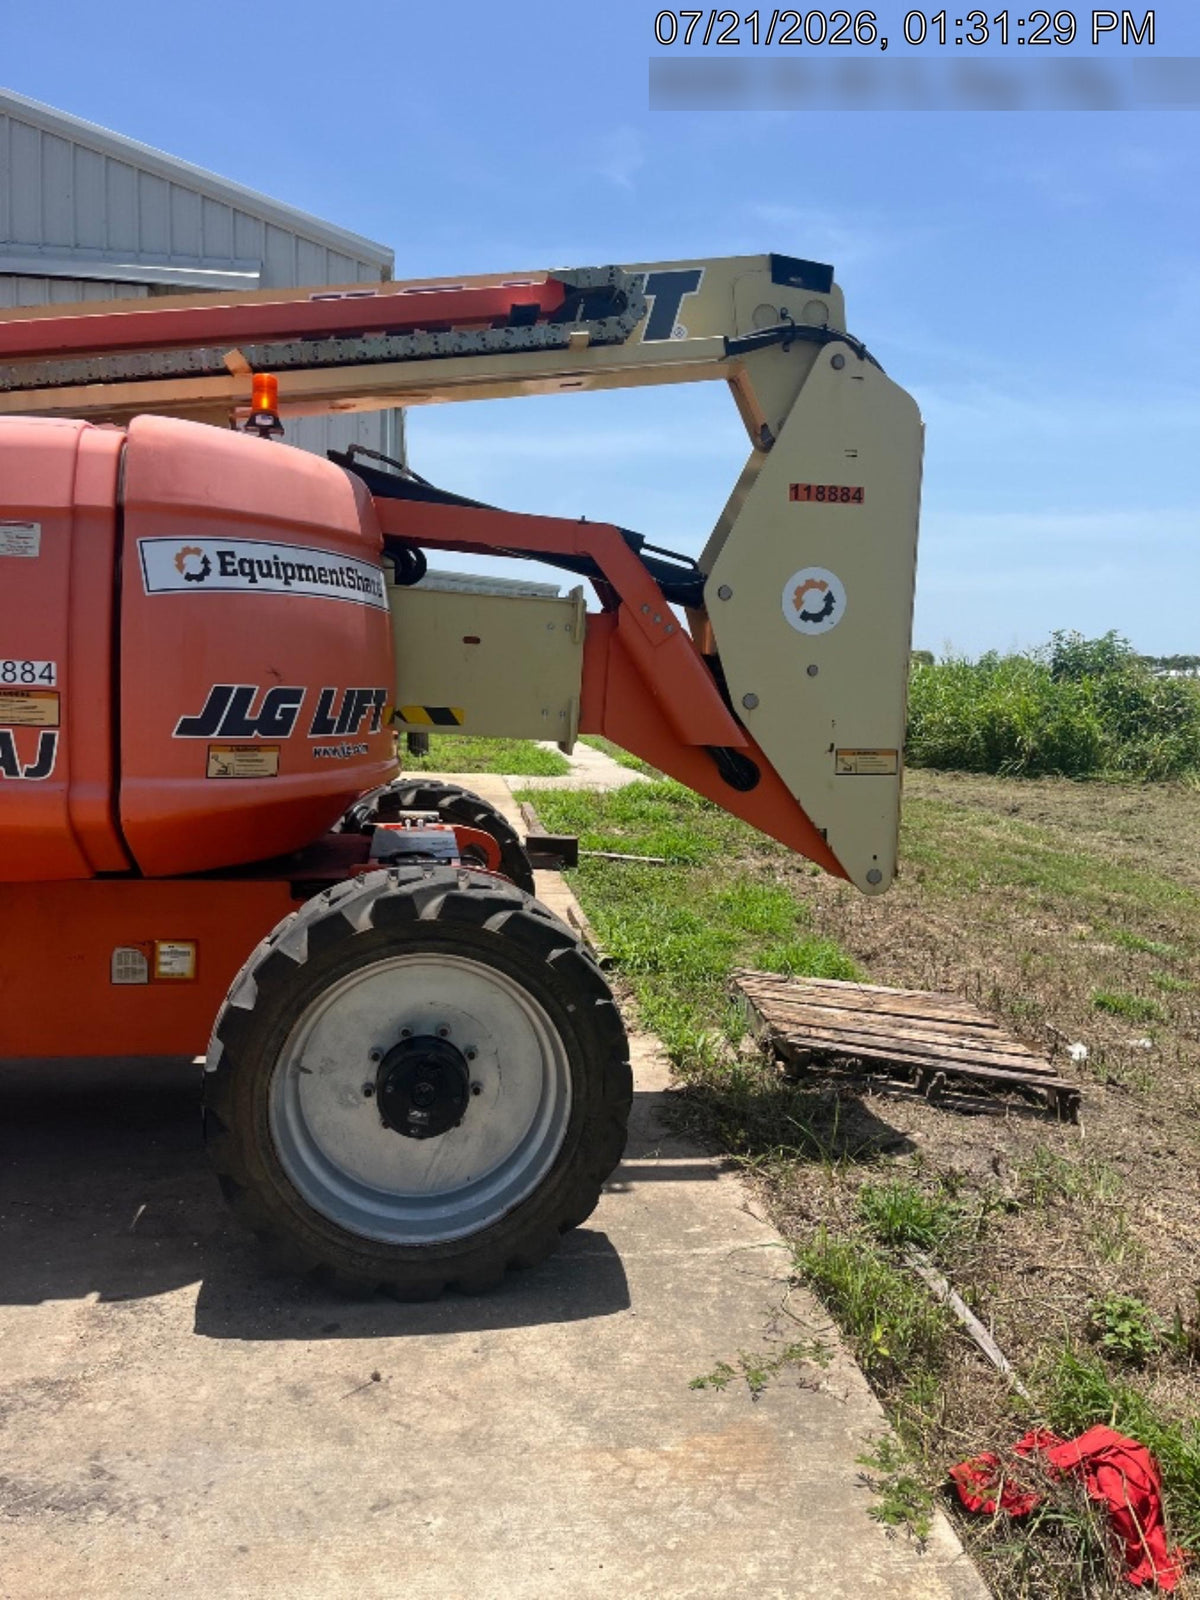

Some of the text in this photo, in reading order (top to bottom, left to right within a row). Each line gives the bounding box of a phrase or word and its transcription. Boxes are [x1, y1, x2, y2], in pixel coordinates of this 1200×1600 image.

[790, 484, 863, 504] 118884
[172, 684, 388, 738] JLG LIFT
